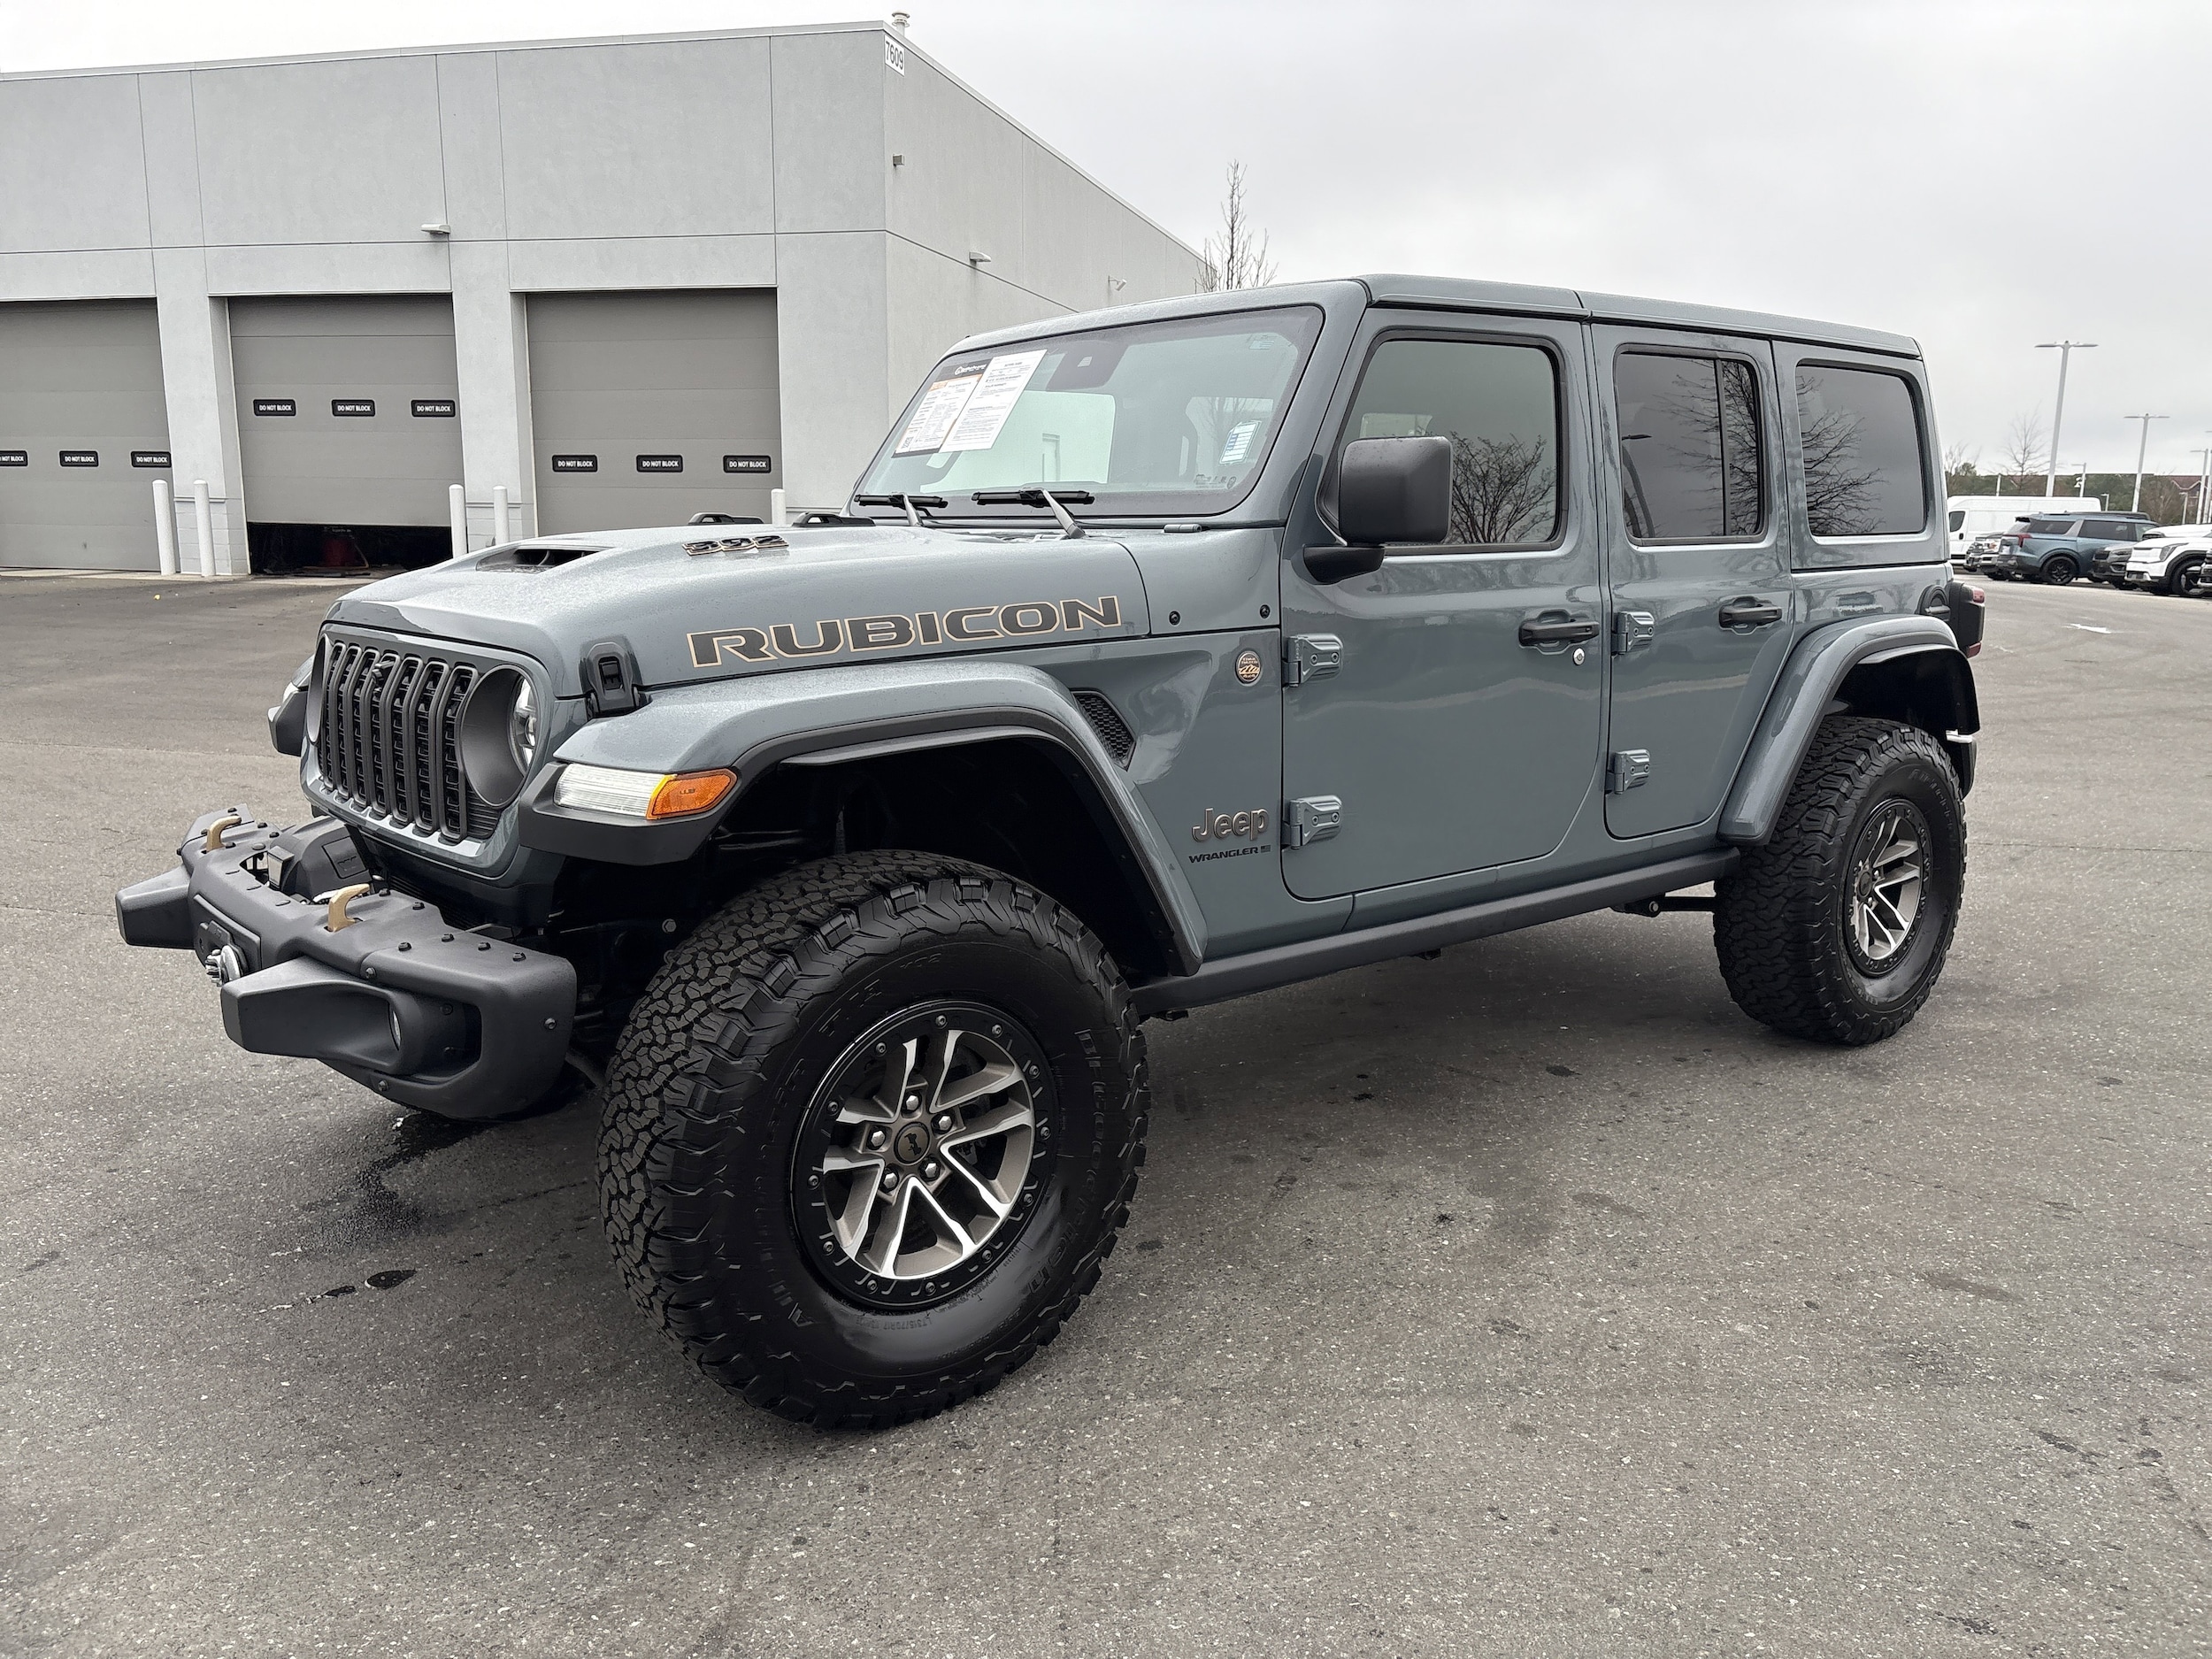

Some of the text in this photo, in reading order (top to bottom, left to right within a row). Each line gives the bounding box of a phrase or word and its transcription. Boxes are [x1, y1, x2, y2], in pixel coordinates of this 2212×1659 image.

[886, 41, 903, 70] 7609
[680, 534, 789, 557] 392
[687, 595, 1122, 668] RUBICON
[1192, 807, 1270, 842] Jeep
[1188, 847, 1259, 864] WRANGLER
